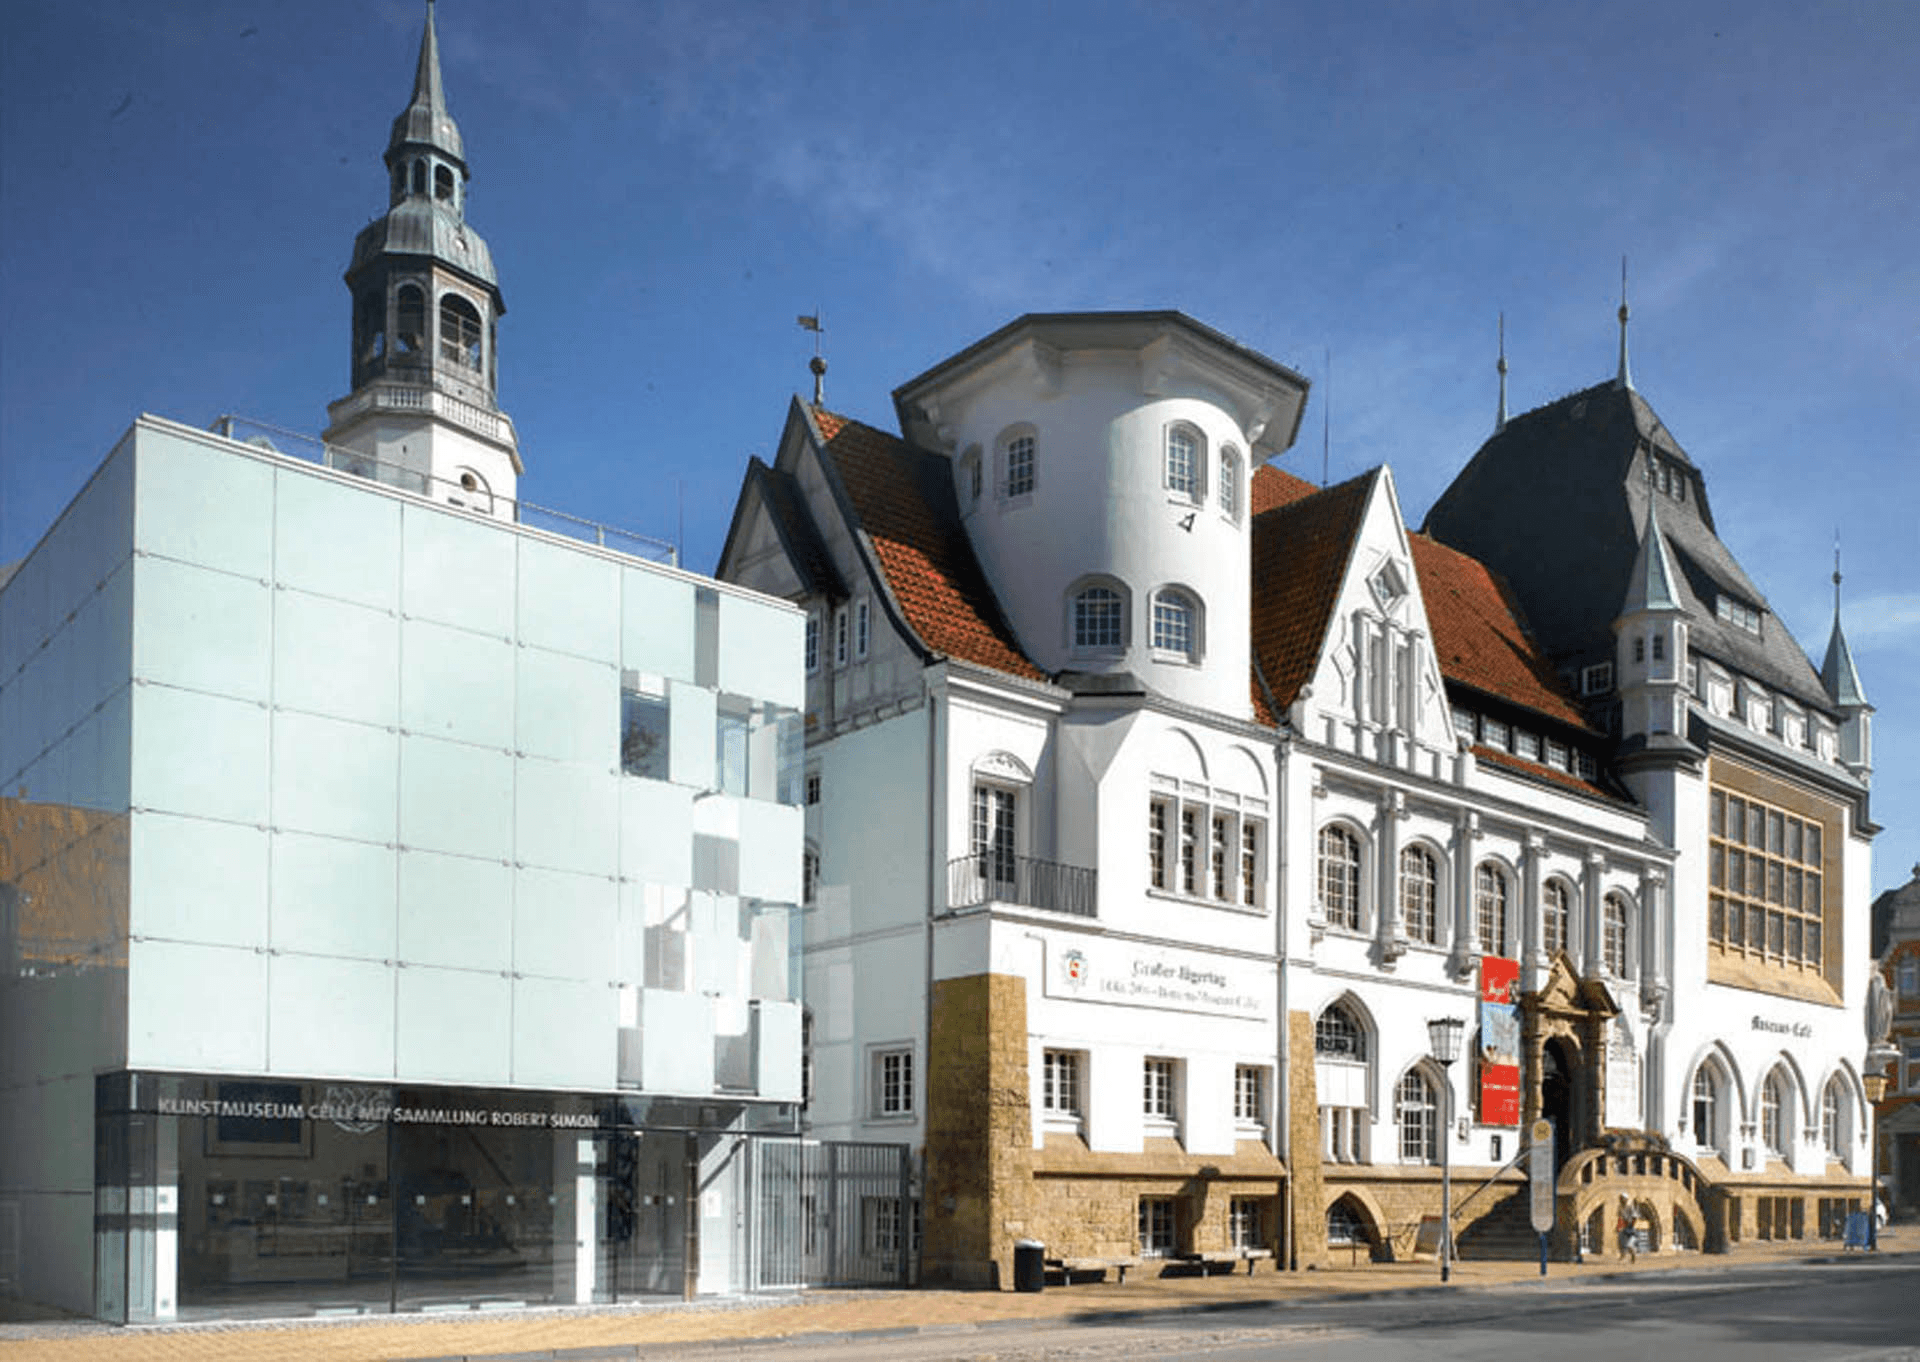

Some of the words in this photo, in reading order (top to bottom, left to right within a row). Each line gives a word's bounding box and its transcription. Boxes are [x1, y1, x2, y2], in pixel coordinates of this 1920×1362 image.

[159, 1097, 303, 1119] KUNSTMUSEUM
[393, 1107, 488, 1125] SAMMLUNG
[492, 1111, 547, 1126] ROBERT
[550, 1113, 600, 1128] SIMON
